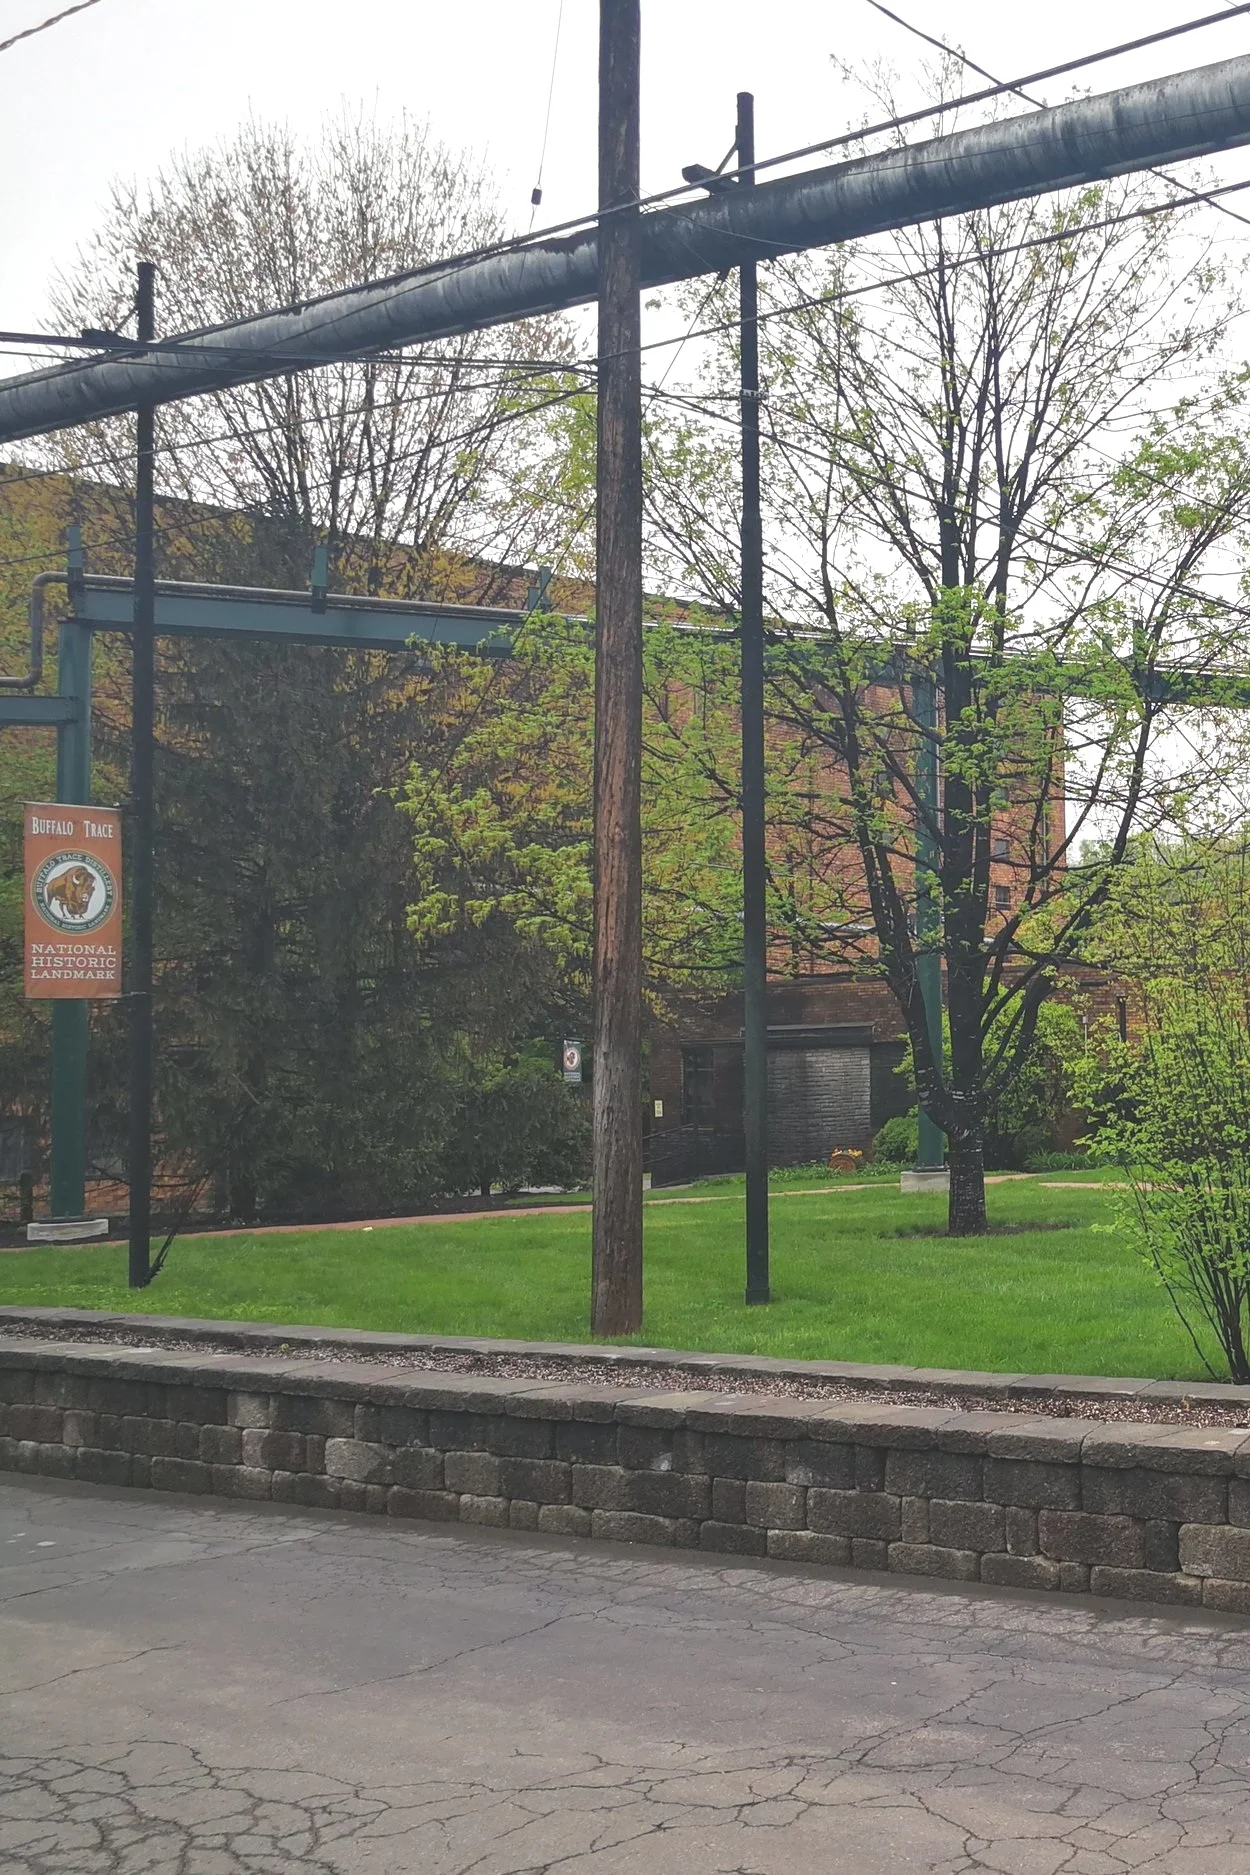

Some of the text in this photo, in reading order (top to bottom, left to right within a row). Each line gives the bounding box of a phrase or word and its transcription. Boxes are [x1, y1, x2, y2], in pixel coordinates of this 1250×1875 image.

[32, 816, 114, 838] BUFFALO TRACE
[36, 853, 113, 896] BUFFALO TRACE DISTILLERY
[31, 944, 116, 955] NATIONAL
[31, 956, 116, 968] HISTORIC
[31, 969, 116, 980] LANDMARK
